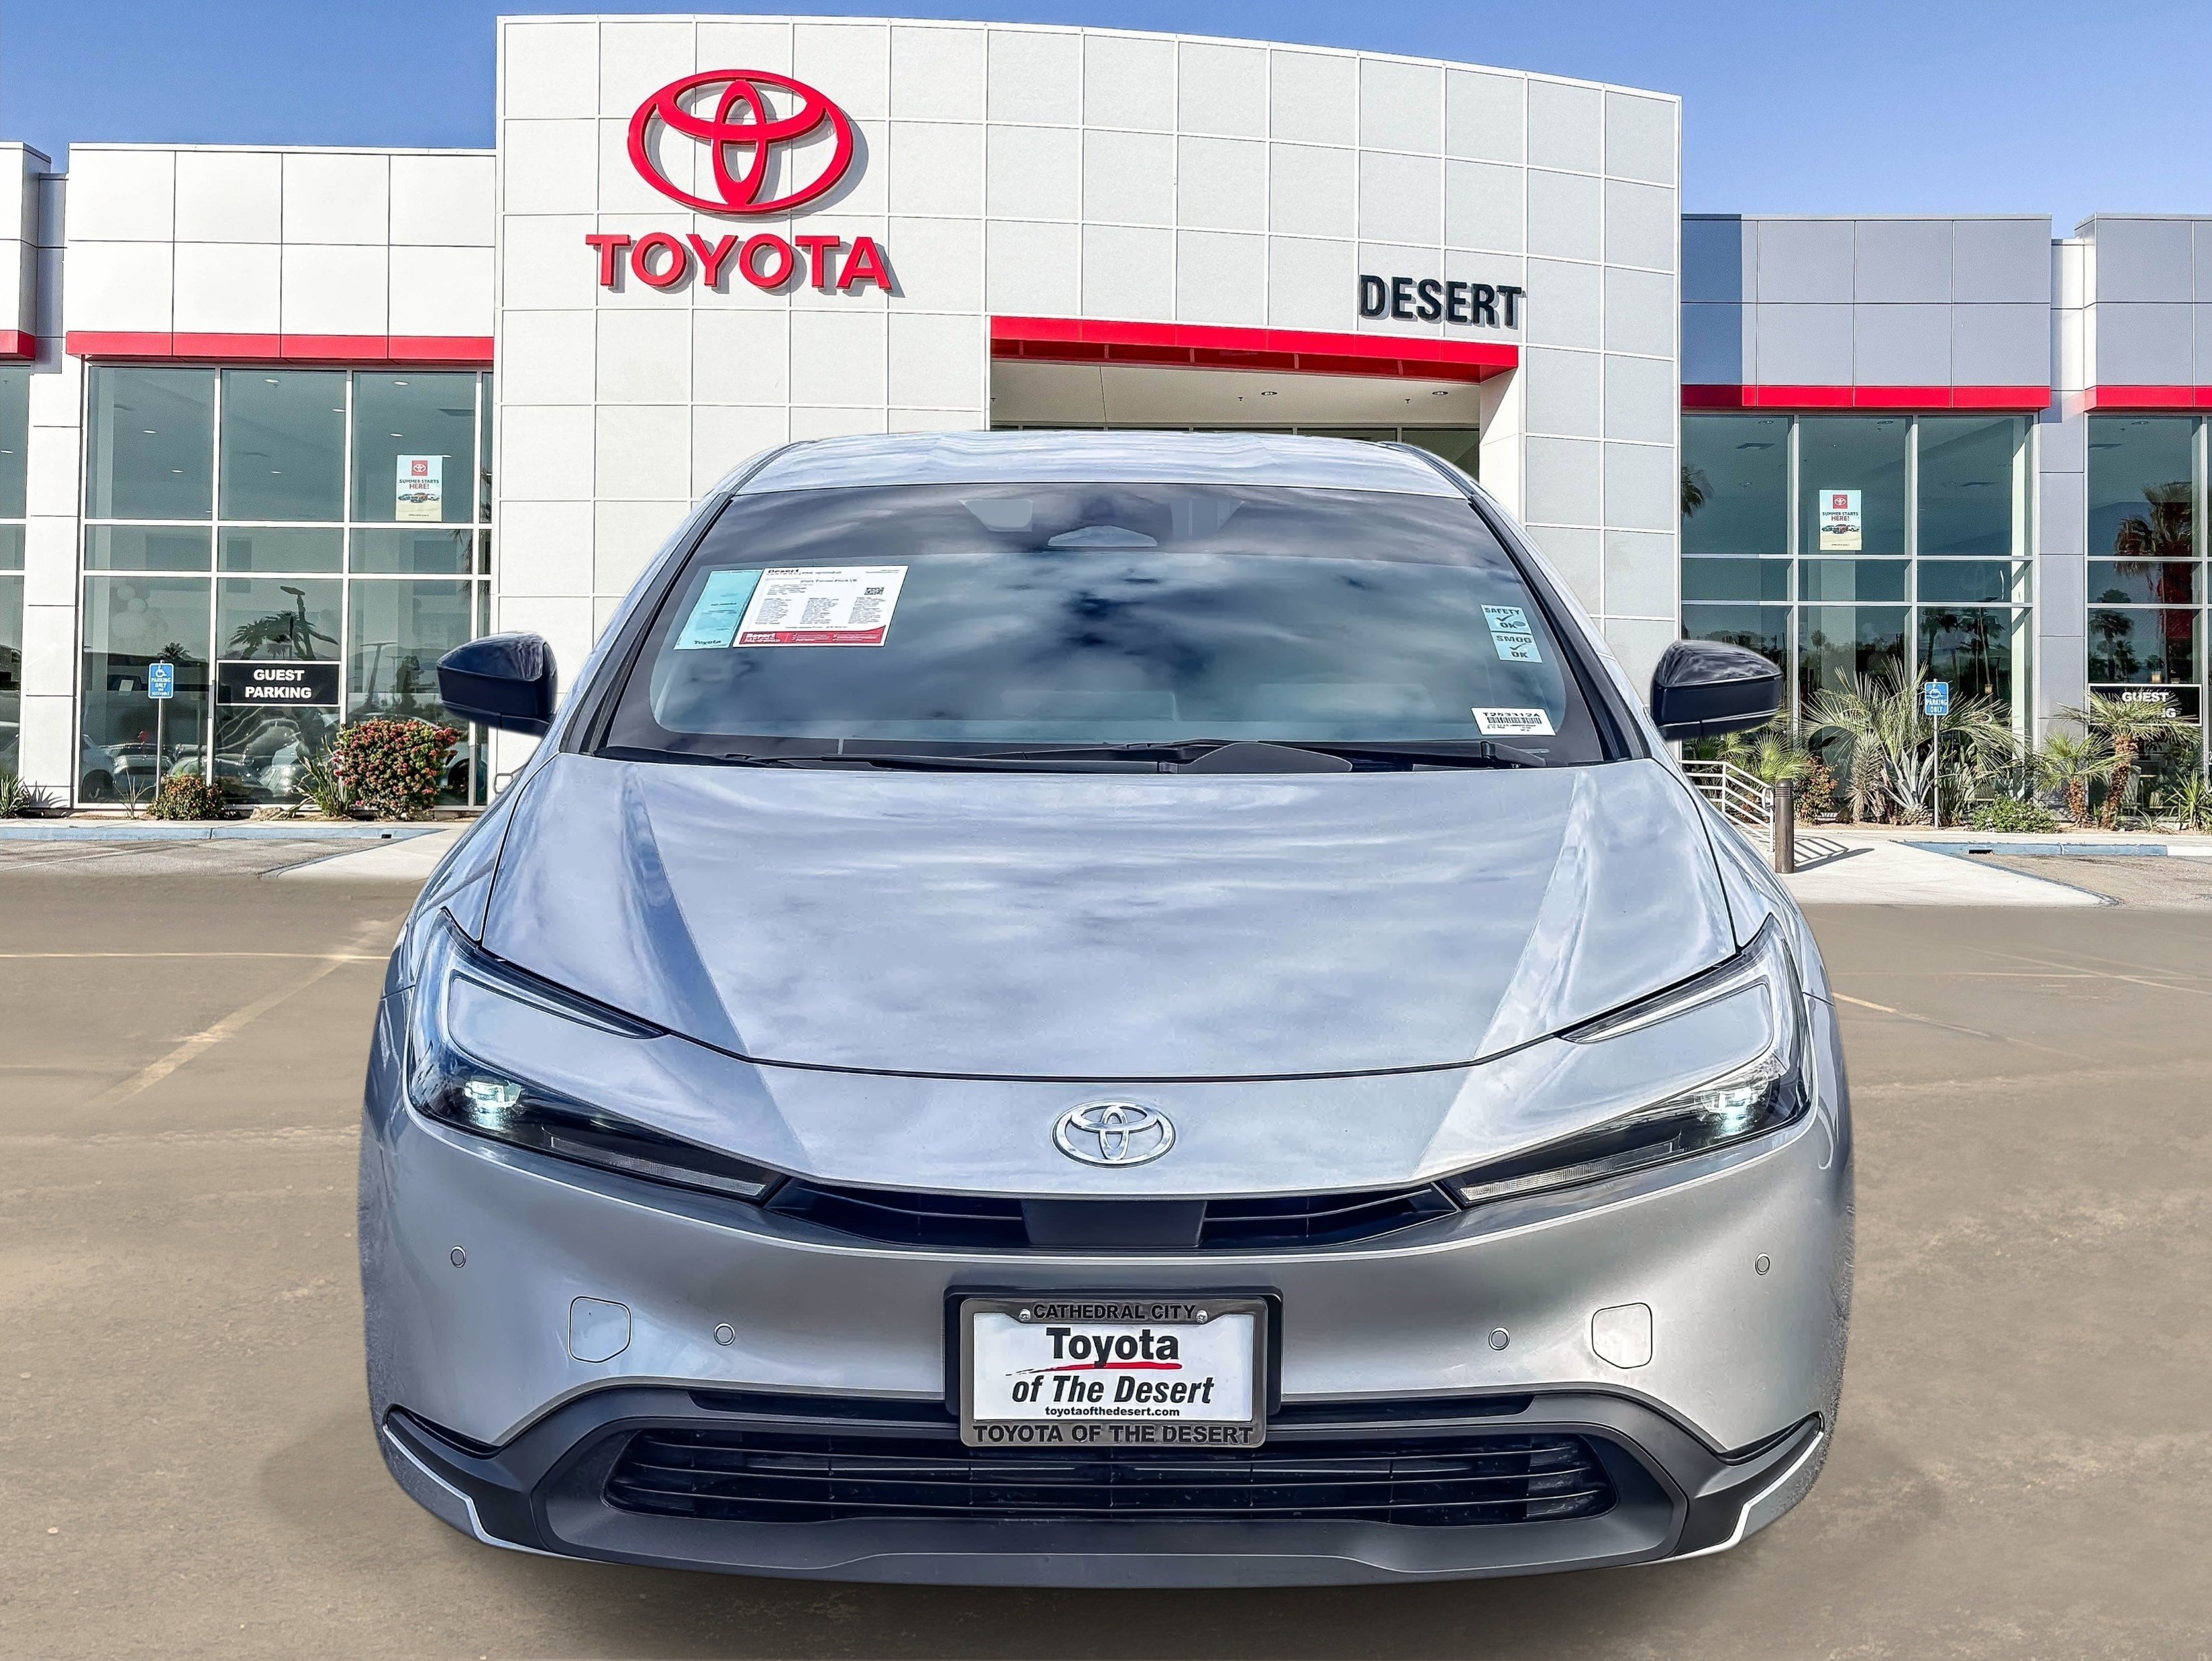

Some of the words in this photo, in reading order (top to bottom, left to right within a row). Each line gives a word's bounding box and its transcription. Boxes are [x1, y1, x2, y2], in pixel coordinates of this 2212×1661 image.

[585, 232, 892, 291] TOYOTA
[1359, 274, 1522, 327] DESERT
[1496, 635, 1532, 644] SMOG
[253, 669, 305, 681] GUEST
[245, 686, 312, 699] PARKING
[2121, 691, 2169, 702] GUEST
[1034, 1304, 1145, 1319] CATHEDRAL
[1151, 1305, 1196, 1319] CITY
[1046, 1327, 1180, 1368] Toyota
[1012, 1376, 1044, 1402] of
[1053, 1376, 1105, 1403] The
[1114, 1376, 1215, 1404] Desert
[1046, 1407, 1180, 1417] toyotaofthedesert.com
[973, 1424, 1062, 1442] TOYOTA
[1072, 1424, 1102, 1443] OF
[1109, 1424, 1156, 1443] THE
[1162, 1425, 1254, 1444] DESERT
